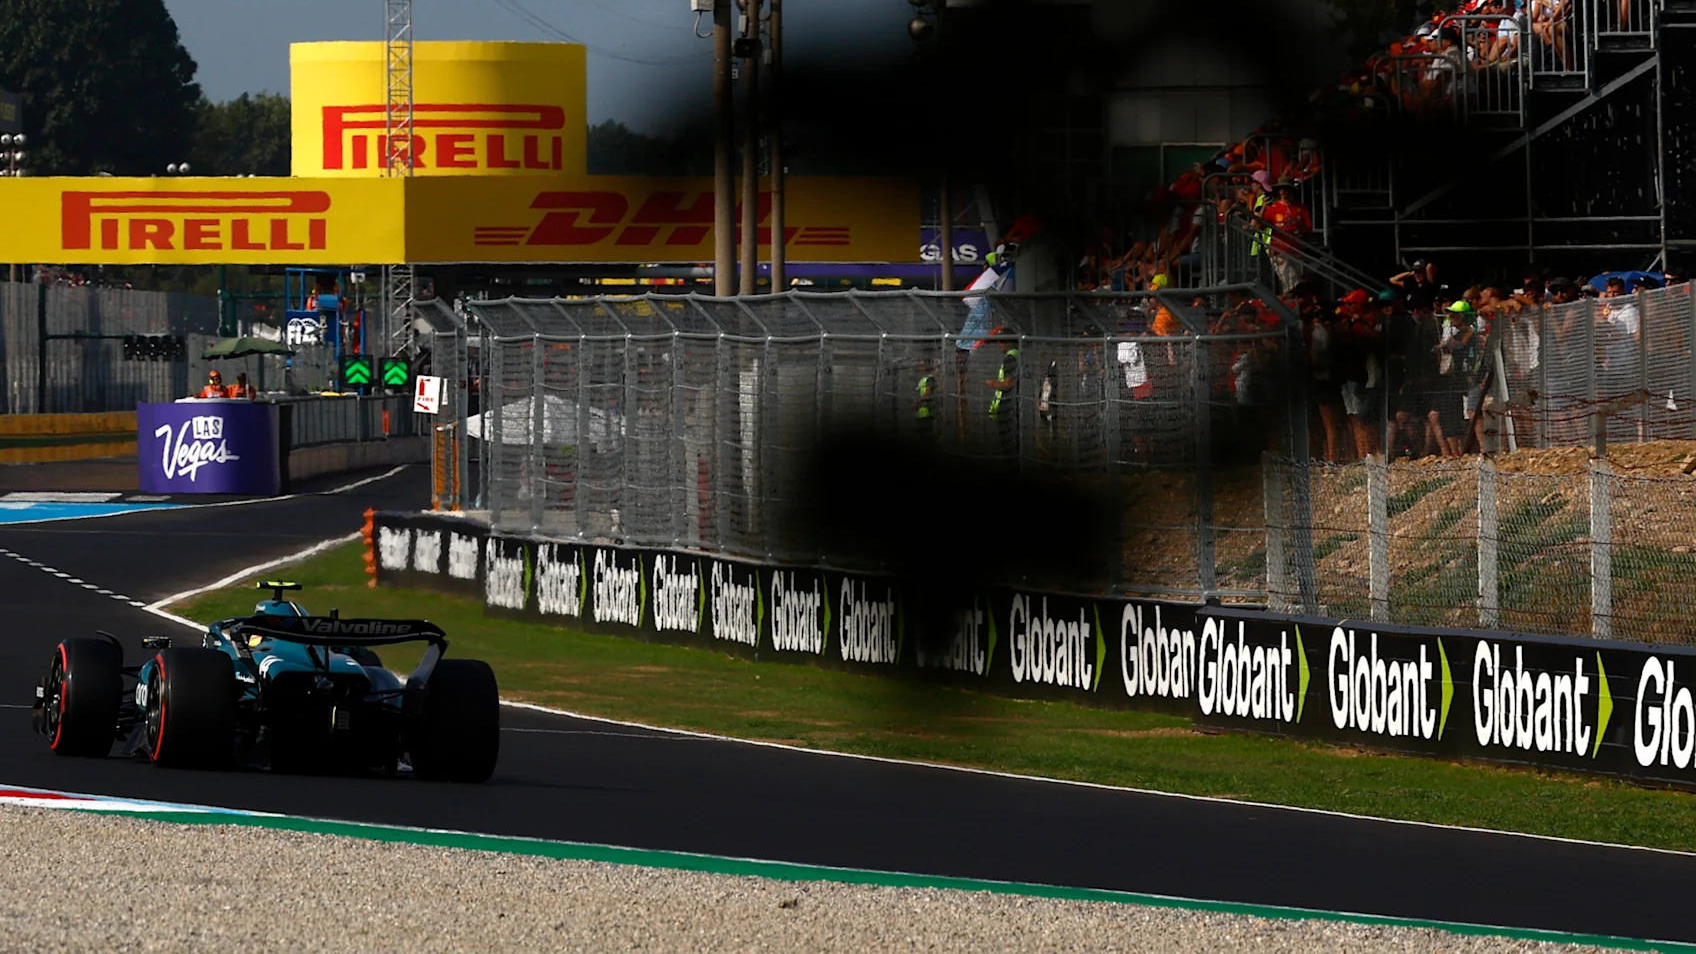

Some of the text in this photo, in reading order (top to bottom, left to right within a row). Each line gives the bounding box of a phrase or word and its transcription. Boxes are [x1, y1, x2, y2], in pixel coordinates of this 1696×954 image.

[322, 104, 565, 170] PIRELLI
[61, 190, 331, 250] PIRELLI
[154, 420, 240, 482] Vegas
[195, 419, 220, 436] LAS
[304, 618, 413, 636] Valvoline
[592, 548, 639, 627] Globant
[653, 553, 698, 633] Globant
[711, 560, 756, 648] Globant
[771, 569, 822, 655] Globant
[839, 576, 896, 664] Globant
[1009, 592, 1092, 691] Globant
[1198, 616, 1295, 723] Globant
[1328, 626, 1437, 739] Globant
[1472, 639, 1592, 757] Globant
[1633, 655, 1696, 770] Glo
